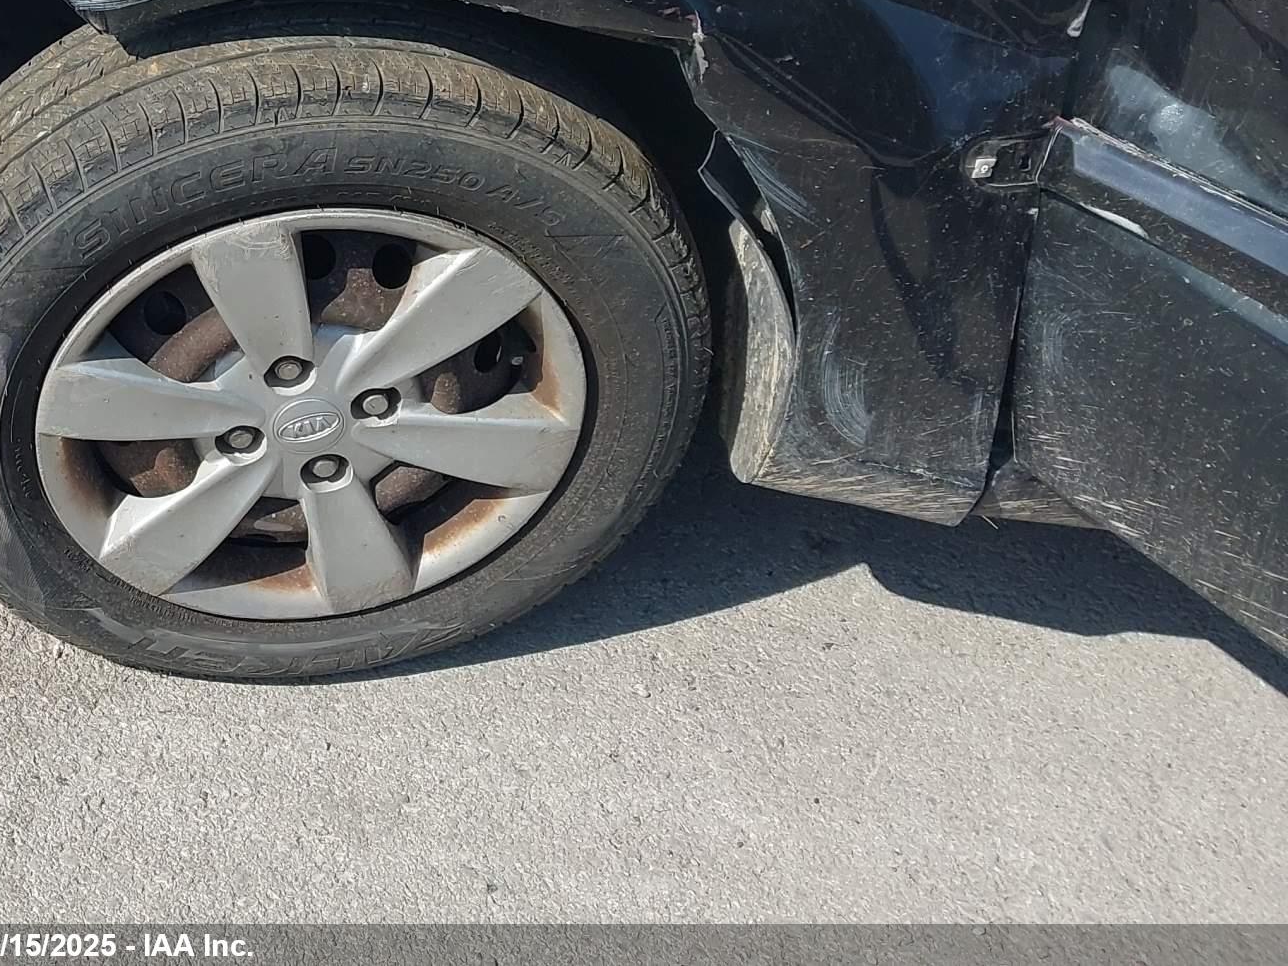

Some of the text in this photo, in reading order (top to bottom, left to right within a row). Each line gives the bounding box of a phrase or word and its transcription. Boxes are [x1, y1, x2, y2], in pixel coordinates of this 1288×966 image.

[72, 146, 562, 261] SINCERA SN250 A/S
[285, 416, 332, 439] KIA
